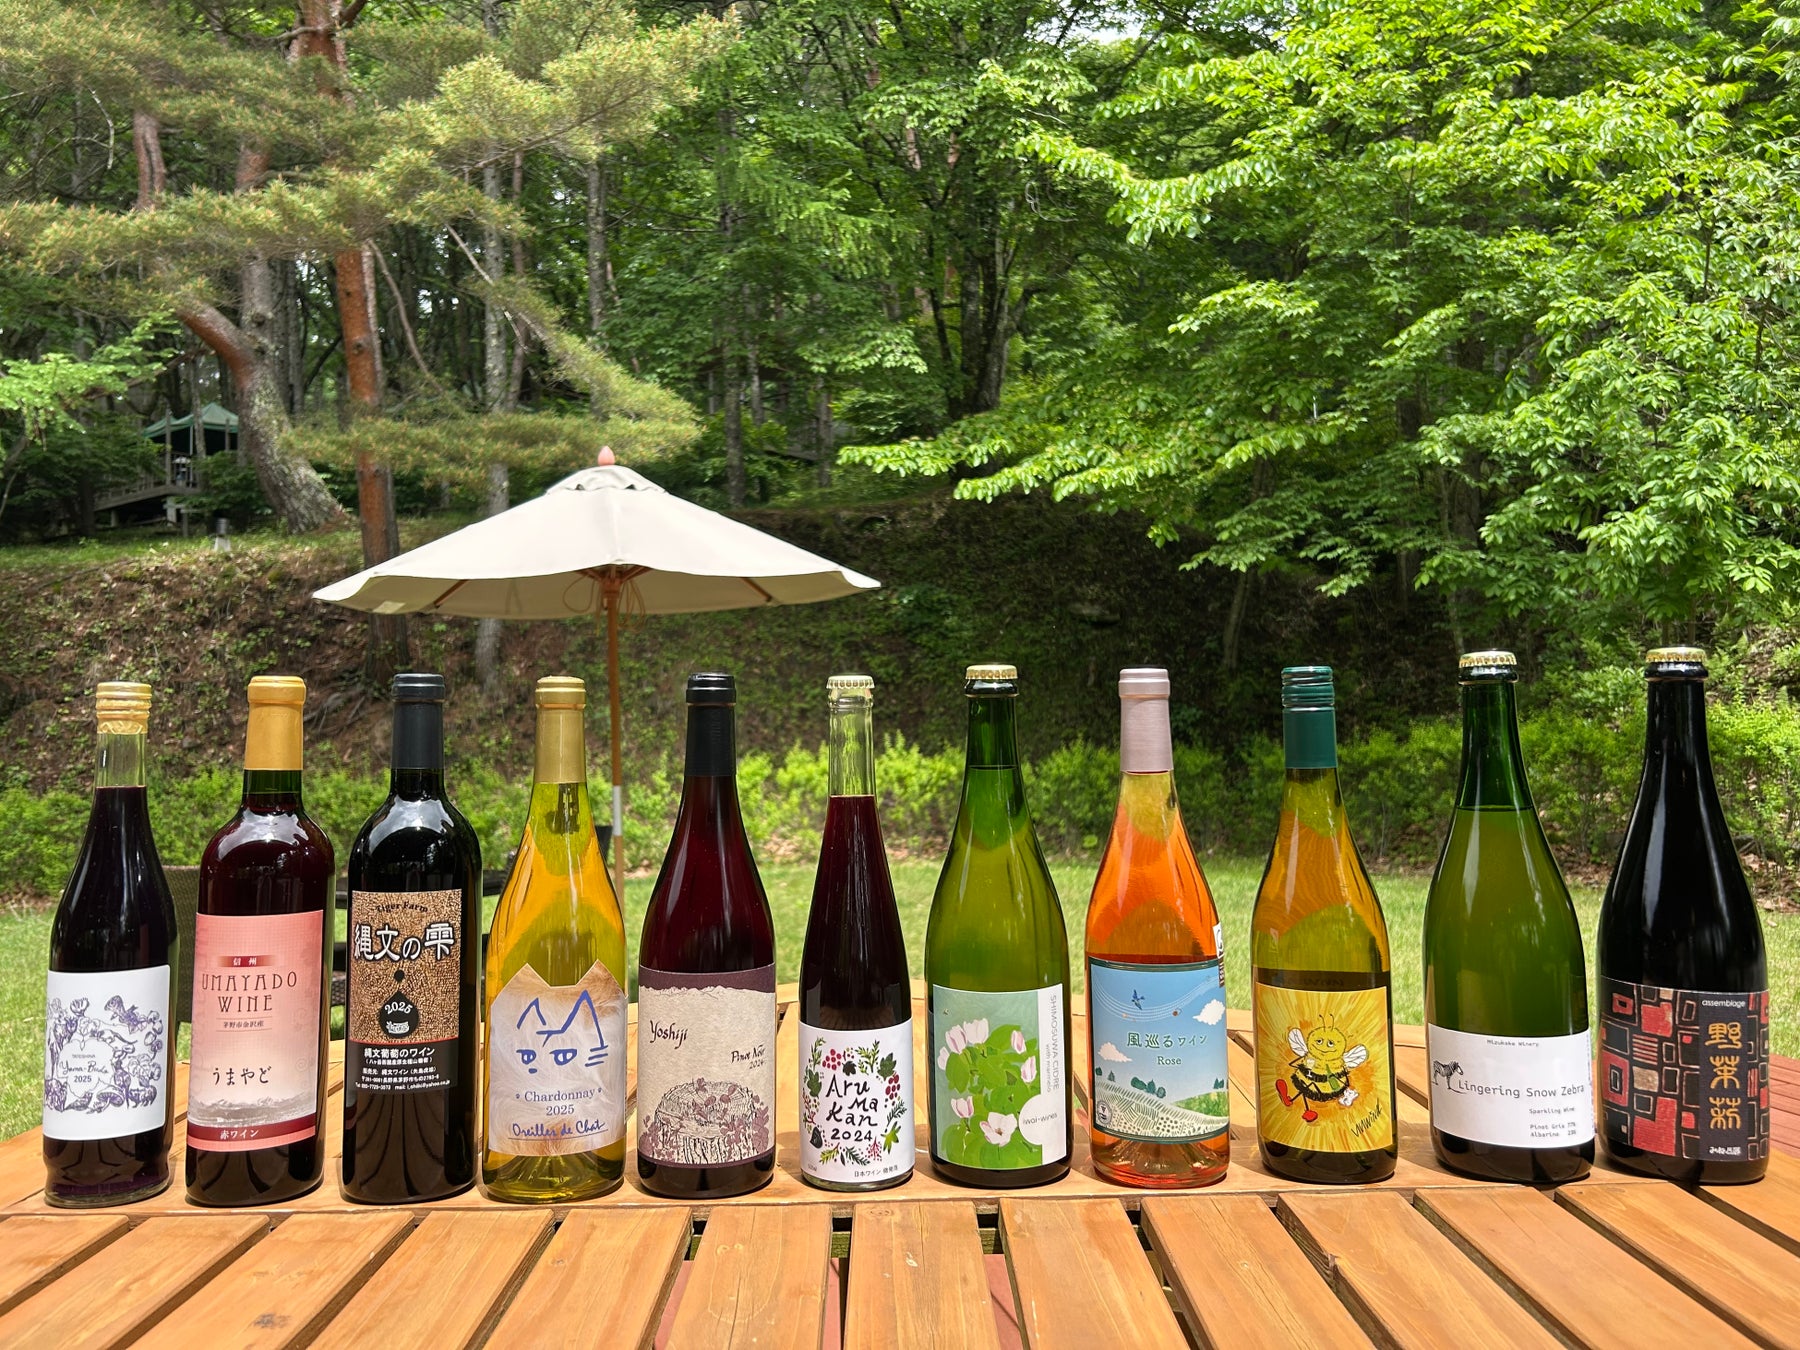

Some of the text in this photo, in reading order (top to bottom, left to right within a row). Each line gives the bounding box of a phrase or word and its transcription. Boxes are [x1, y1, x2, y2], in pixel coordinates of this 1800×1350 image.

[403, 900, 428, 913] Farm
[354, 922, 455, 961] 縄文の雫
[202, 971, 297, 992] UMAYADO
[218, 994, 273, 1013] WINE
[384, 1001, 413, 1015] 2025
[1702, 999, 1746, 1009] assemblage
[649, 1020, 688, 1050] Yoshiji
[1127, 1032, 1207, 1048] 風巡るワイン
[364, 1046, 435, 1059] 縄文葡萄のワイン
[1157, 1055, 1182, 1065] Rose
[74, 1075, 92, 1083] 2025
[212, 1065, 272, 1086] うまやど
[825, 1074, 871, 1098] Aru
[1458, 1080, 1585, 1099] Lingering Snow Zebra
[524, 1088, 595, 1102] Chardonnay
[545, 1105, 575, 1116] 2025
[825, 1101, 878, 1127] Kan
[220, 1129, 259, 1140] 赤ワイン
[561, 1123, 573, 1136] de
[576, 1119, 605, 1134] Chat
[830, 1128, 873, 1142] 2024
[854, 1169, 881, 1178] 日本ワイン
